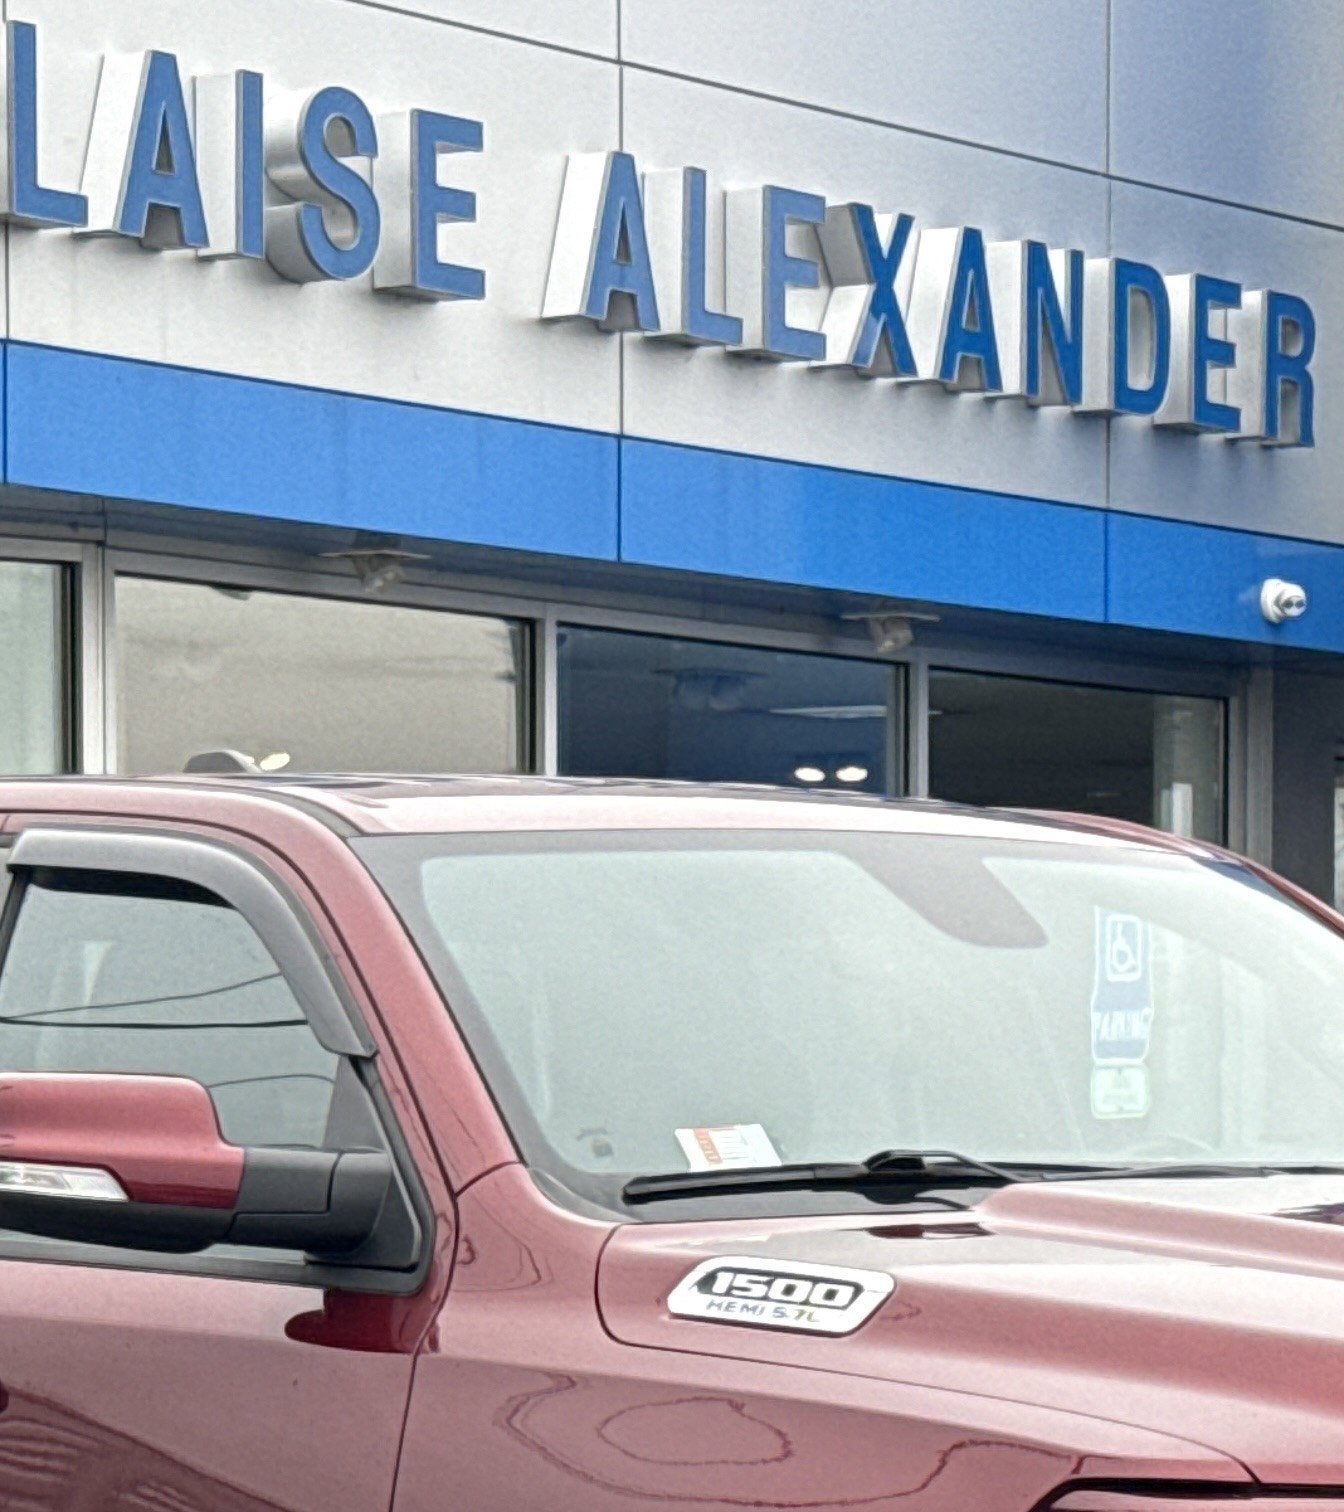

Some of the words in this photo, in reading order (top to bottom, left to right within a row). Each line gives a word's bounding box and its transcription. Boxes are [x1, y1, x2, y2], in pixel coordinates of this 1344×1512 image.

[549, 146, 1318, 449] ALEXANDER
[710, 1271, 857, 1309] 1500
[706, 1298, 766, 1317] HEMI
[772, 1306, 821, 1323] 5.7L
